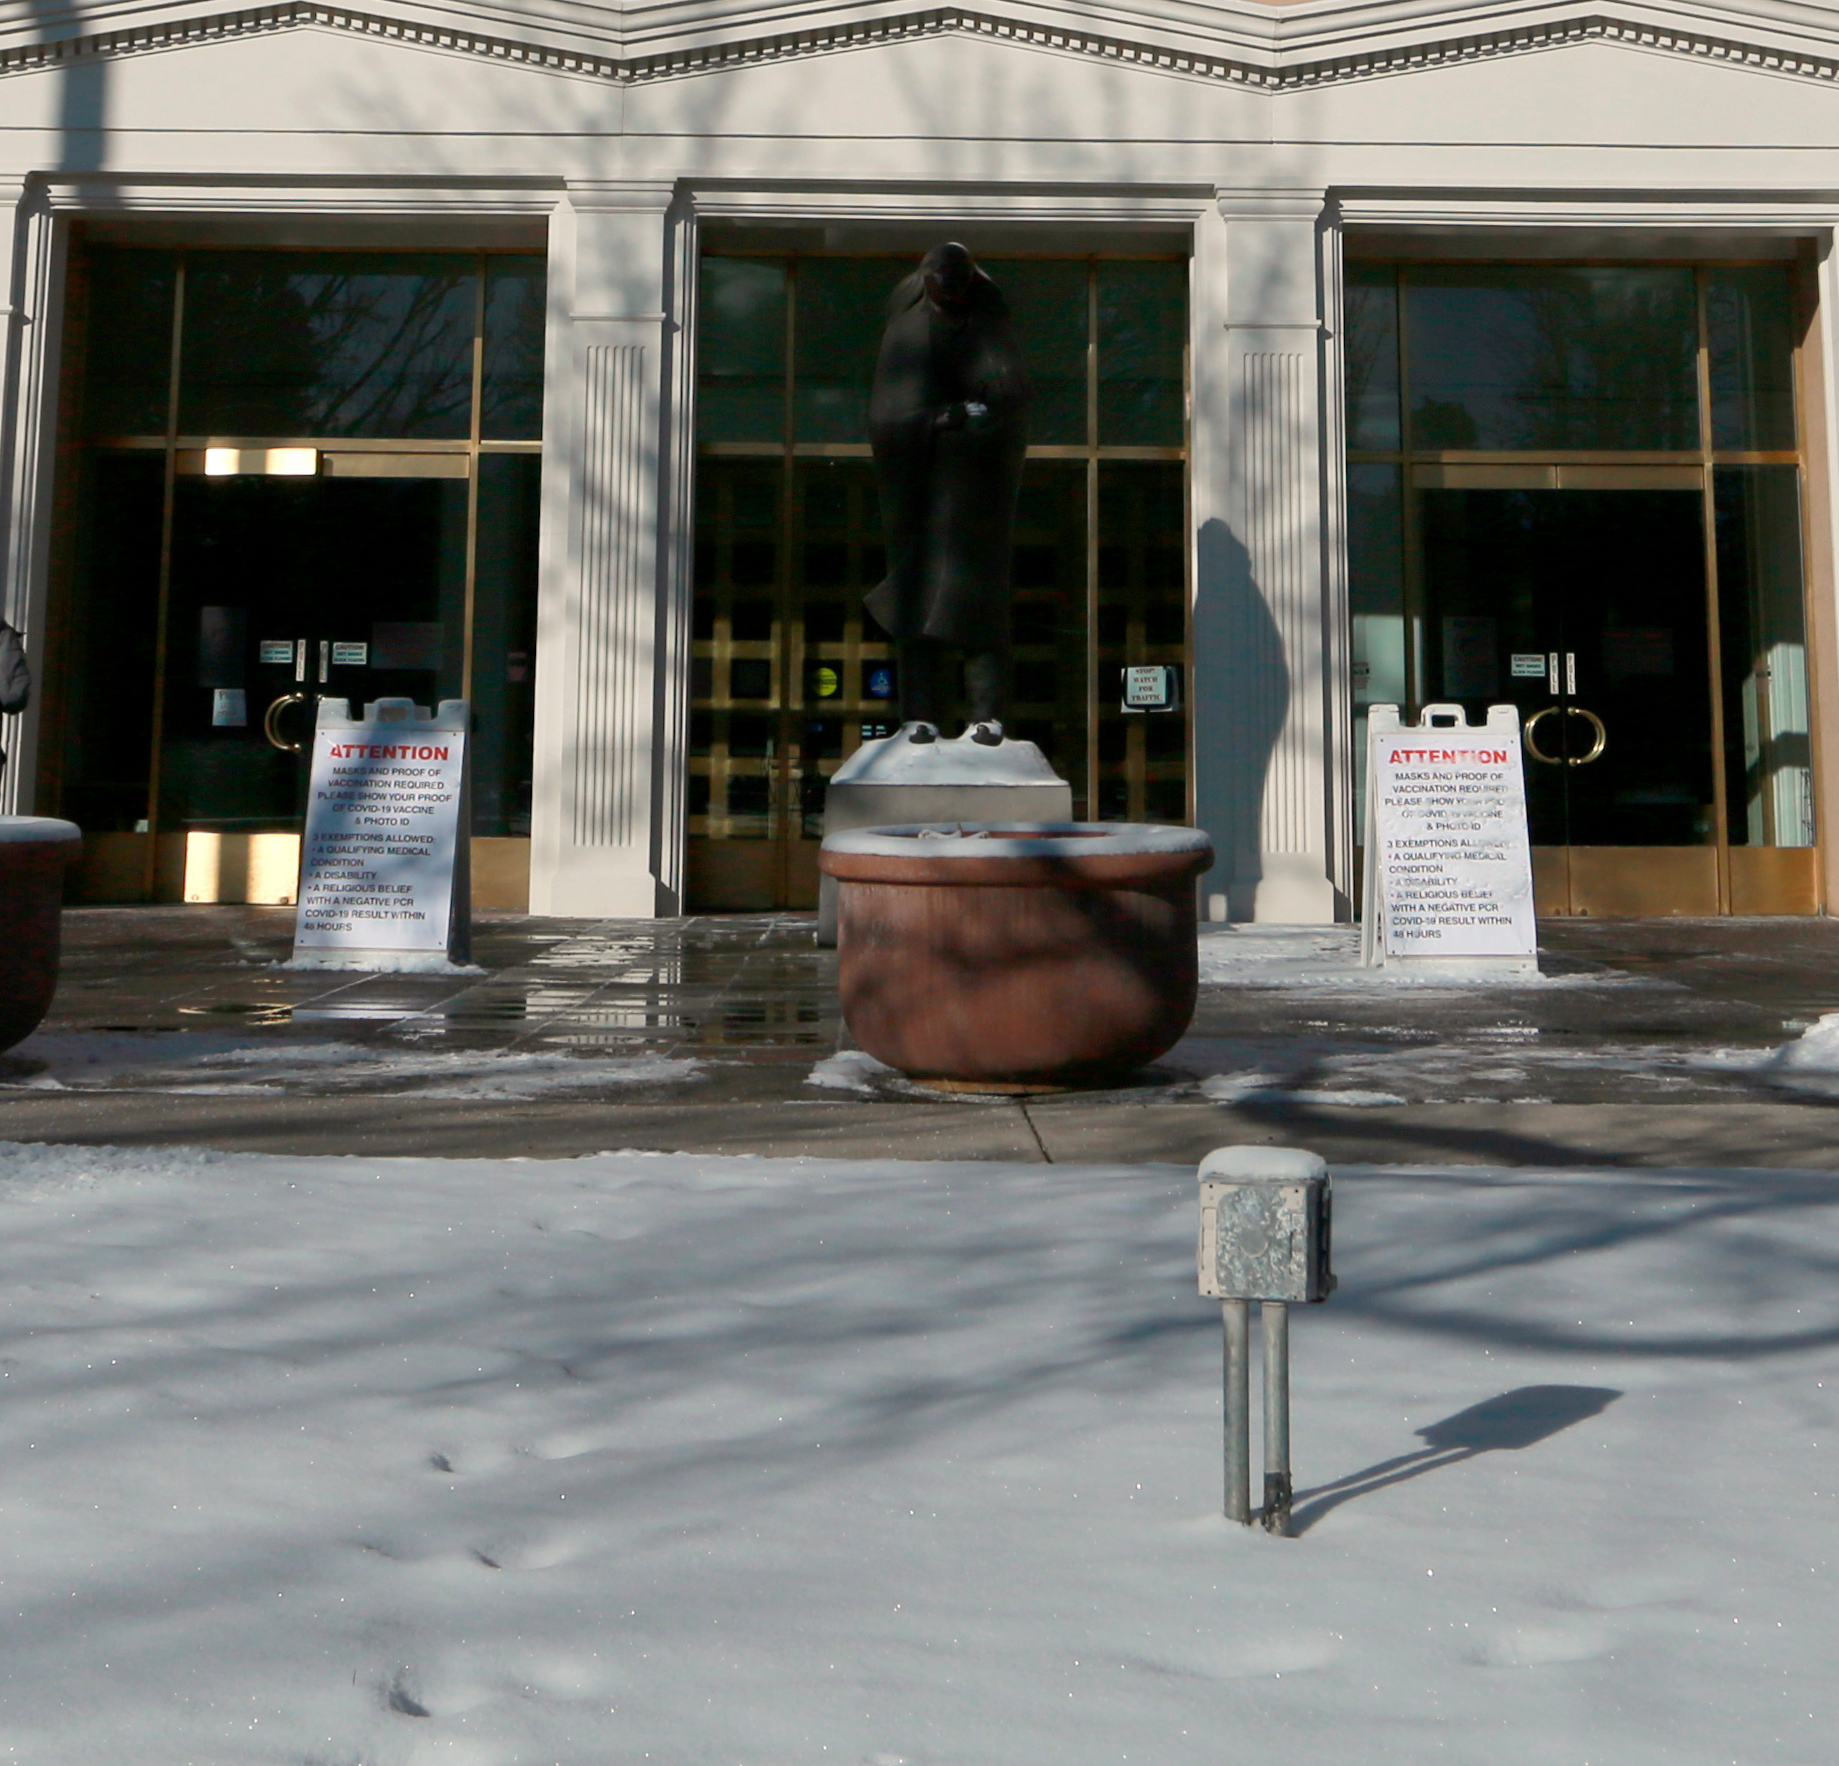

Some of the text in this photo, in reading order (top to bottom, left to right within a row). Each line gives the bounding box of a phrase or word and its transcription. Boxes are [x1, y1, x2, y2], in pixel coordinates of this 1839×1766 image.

[329, 745, 449, 760] ATTENTION
[333, 767, 367, 775] MASKS
[369, 767, 389, 775] AND
[392, 768, 425, 776] PROOF
[1395, 773, 1430, 781] MASKS
[328, 779, 444, 789] VACCINATION REQUIRED
[1392, 785, 1456, 793] VACCINATION
[318, 792, 354, 800] PLEASE
[390, 793, 415, 801] YOUR
[332, 804, 435, 814] OF COVID-19 VACCINE
[400, 818, 409, 826] ID
[321, 834, 383, 842] EXEMPTIONS
[1395, 840, 1458, 848] EXEMPTIONS
[327, 846, 385, 854] QUALIFYING
[311, 859, 364, 867] CONDITION
[1389, 865, 1443, 873] CONDITION
[324, 872, 377, 880] DISABILITY
[322, 884, 376, 892] RELIGIOUS
[378, 885, 413, 893] BELIEF
[1406, 891, 1458, 899] RELIGIOUS
[343, 898, 393, 906] NEGATIVE
[393, 898, 414, 906] PCR
[351, 910, 389, 919] RESULT
[391, 911, 425, 920] WITHIN
[317, 923, 352, 931] HOURS
[1393, 930, 1404, 938] 48
